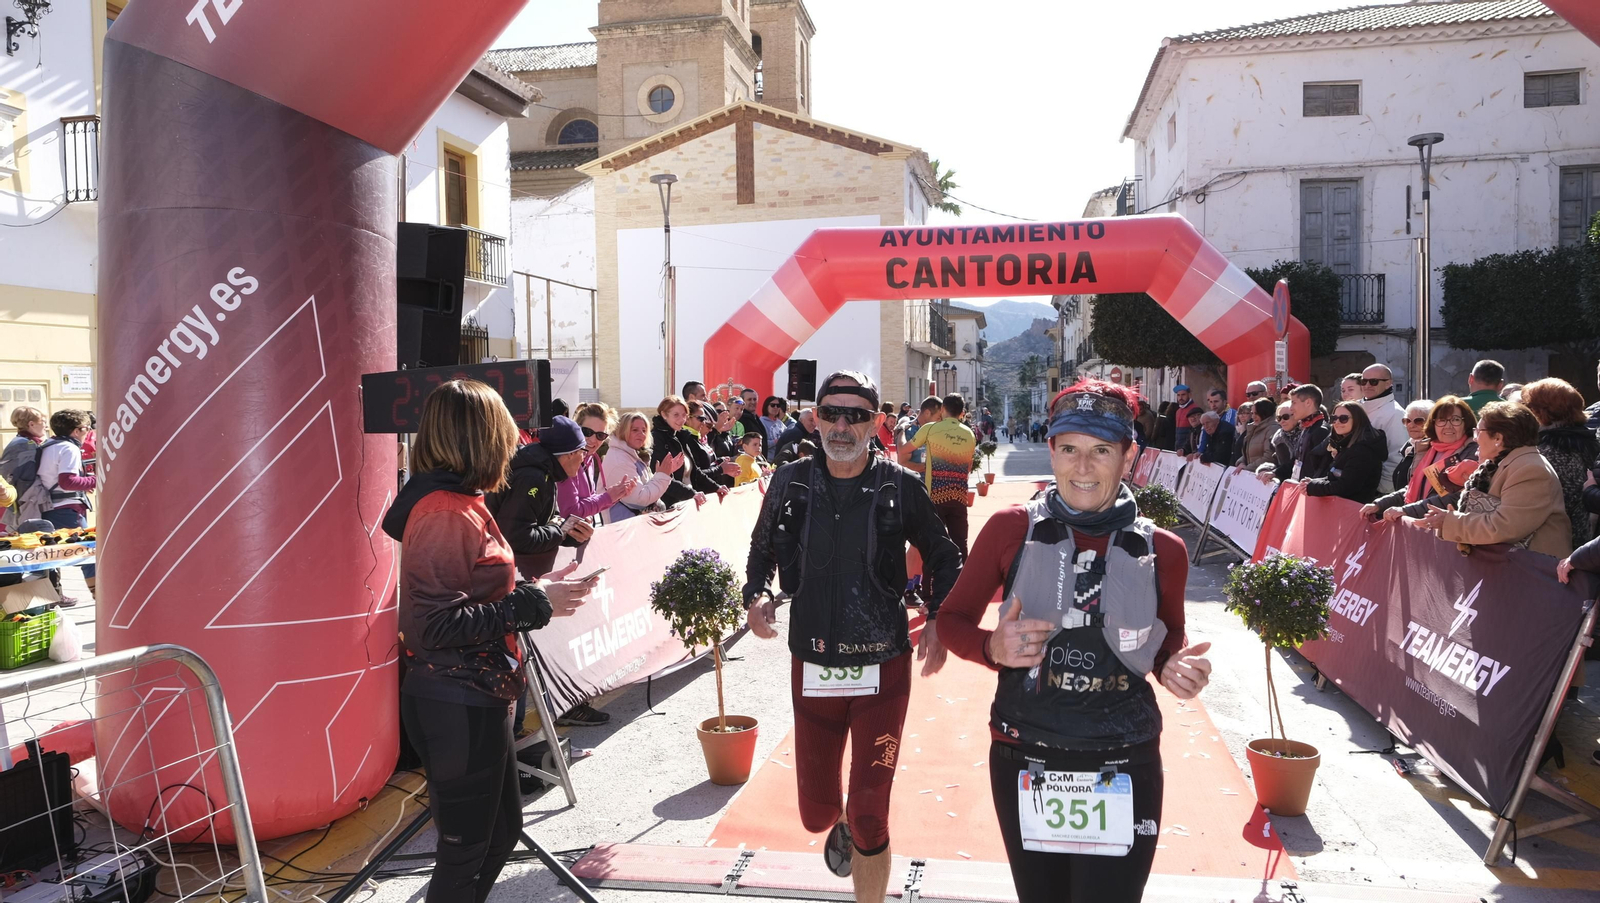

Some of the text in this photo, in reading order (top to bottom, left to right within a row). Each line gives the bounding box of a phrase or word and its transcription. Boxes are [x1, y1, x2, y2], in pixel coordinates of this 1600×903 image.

[879, 221, 1105, 247] AYUNTAMIENTO
[885, 250, 1098, 289] CANTORIA
[568, 603, 653, 671] TEAMERGY
[1049, 642, 1096, 670] pies
[1399, 620, 1511, 697] TEAMERGY
[1405, 675, 1457, 718] www.teamergy.es
[1046, 782, 1093, 794] PÓLVORA
[1049, 772, 1074, 783] CxM
[1045, 797, 1107, 831] 351
